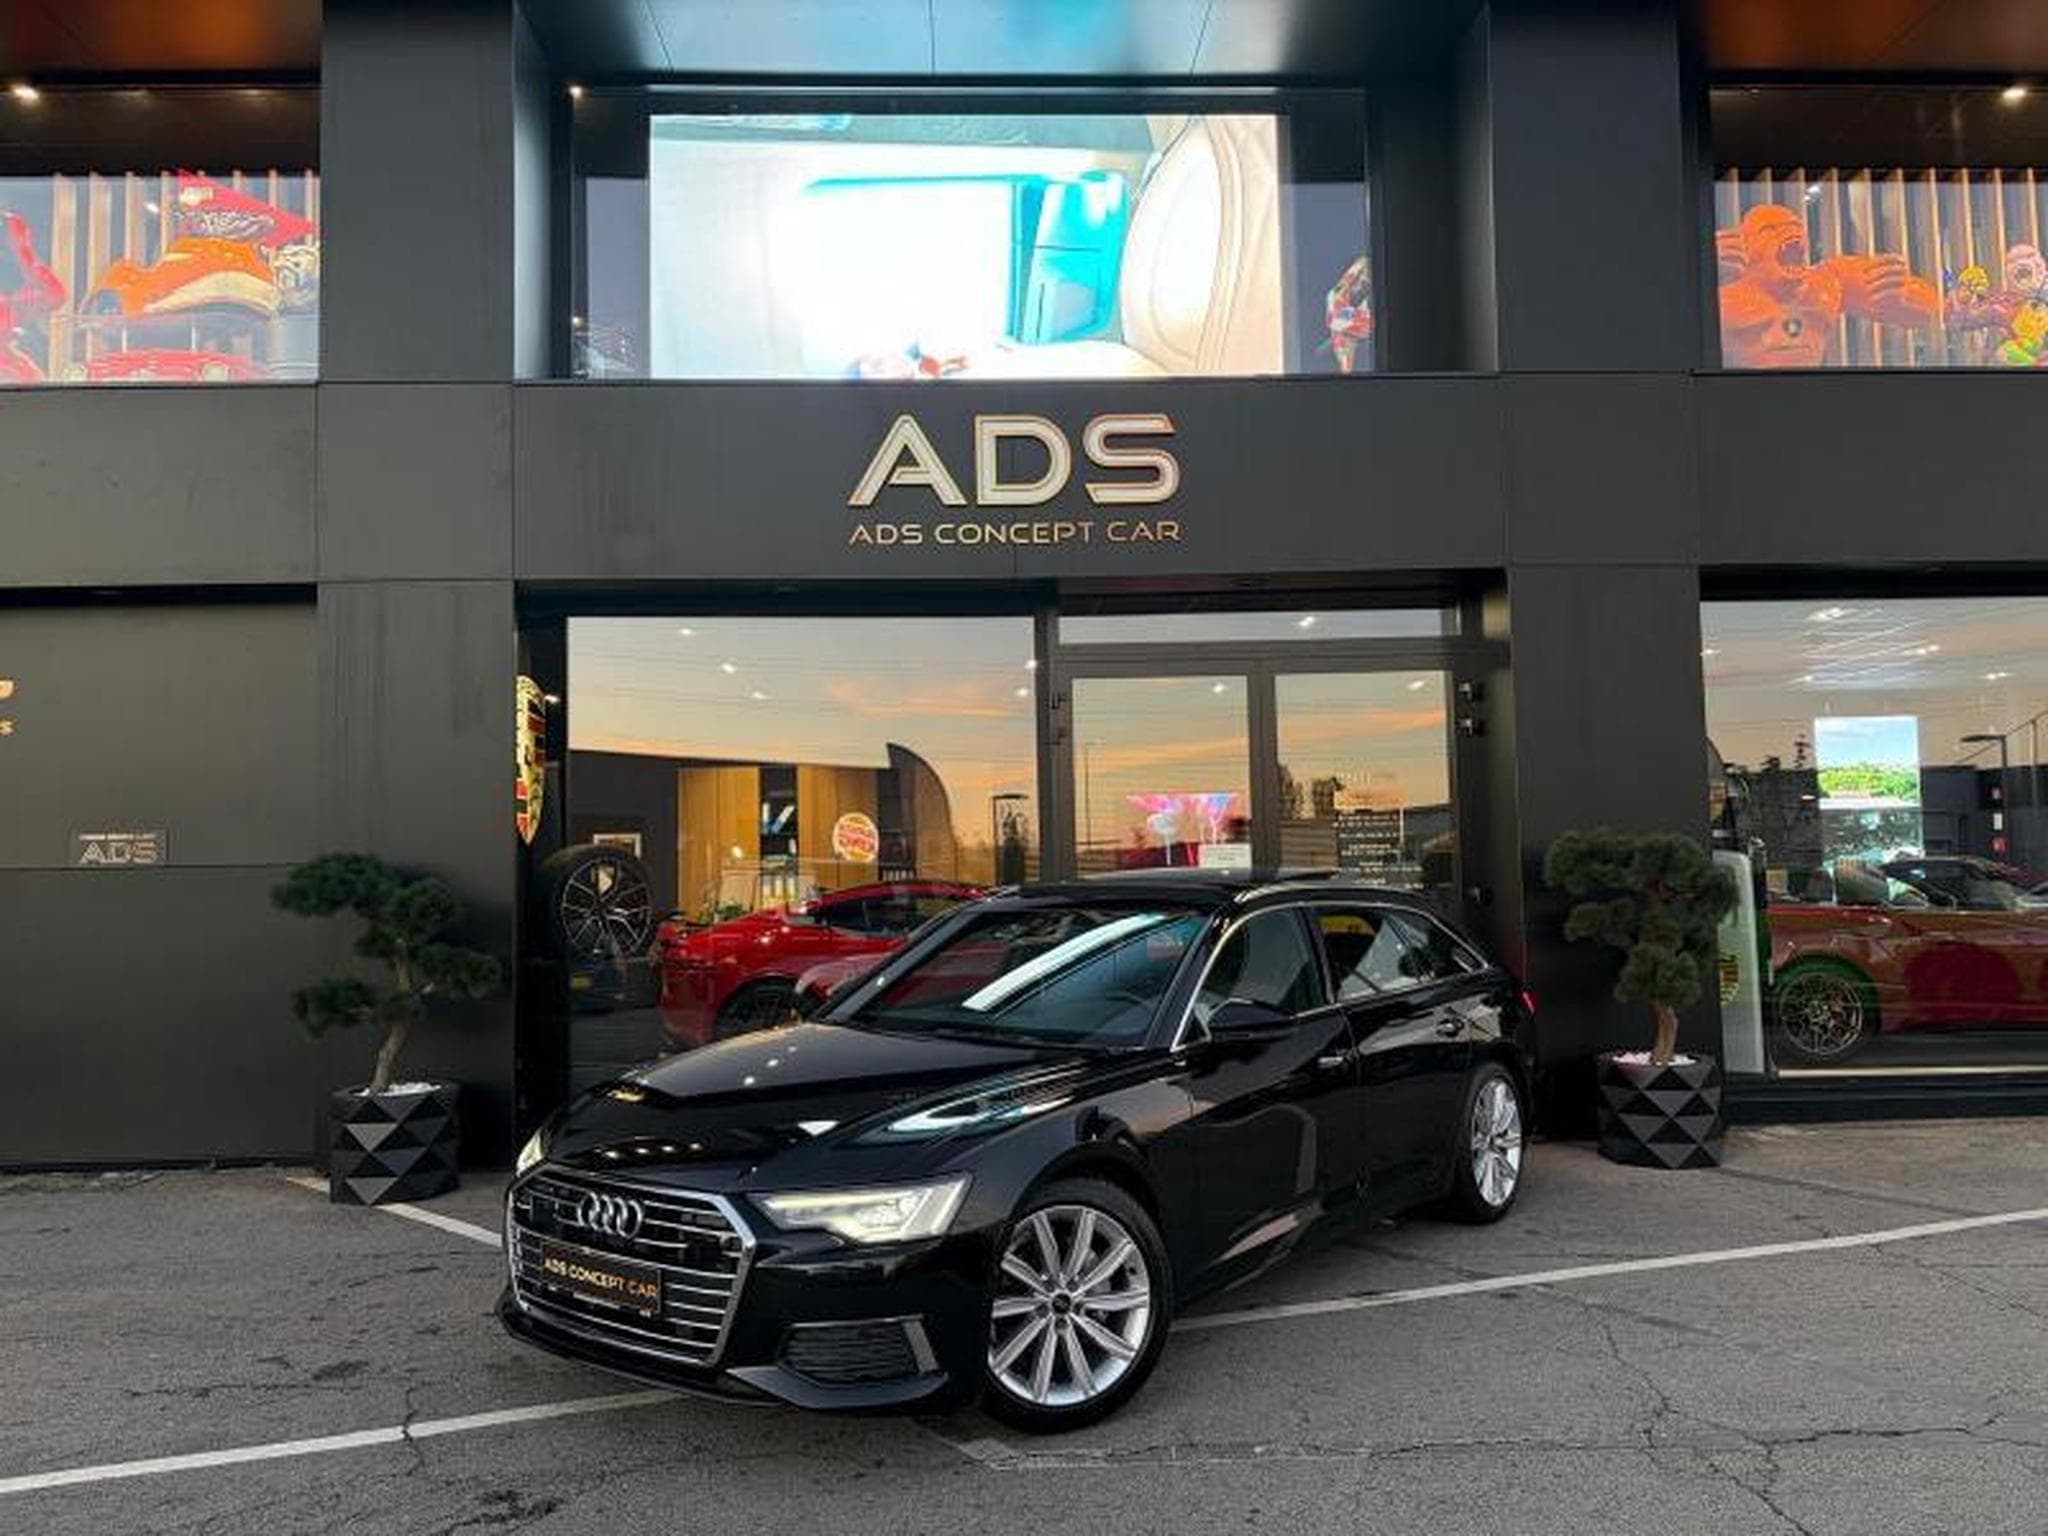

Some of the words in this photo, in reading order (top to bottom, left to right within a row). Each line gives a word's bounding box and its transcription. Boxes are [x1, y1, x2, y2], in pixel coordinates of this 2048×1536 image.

[848, 413, 1181, 506] ADS
[849, 524, 923, 544] ADS
[934, 521, 1095, 544] CONCEPT
[1106, 520, 1182, 542] CAR
[80, 841, 157, 864] ADS
[544, 1257, 567, 1276] ADS
[568, 1264, 624, 1291] CONCEPT
[626, 1280, 657, 1297] CAR
